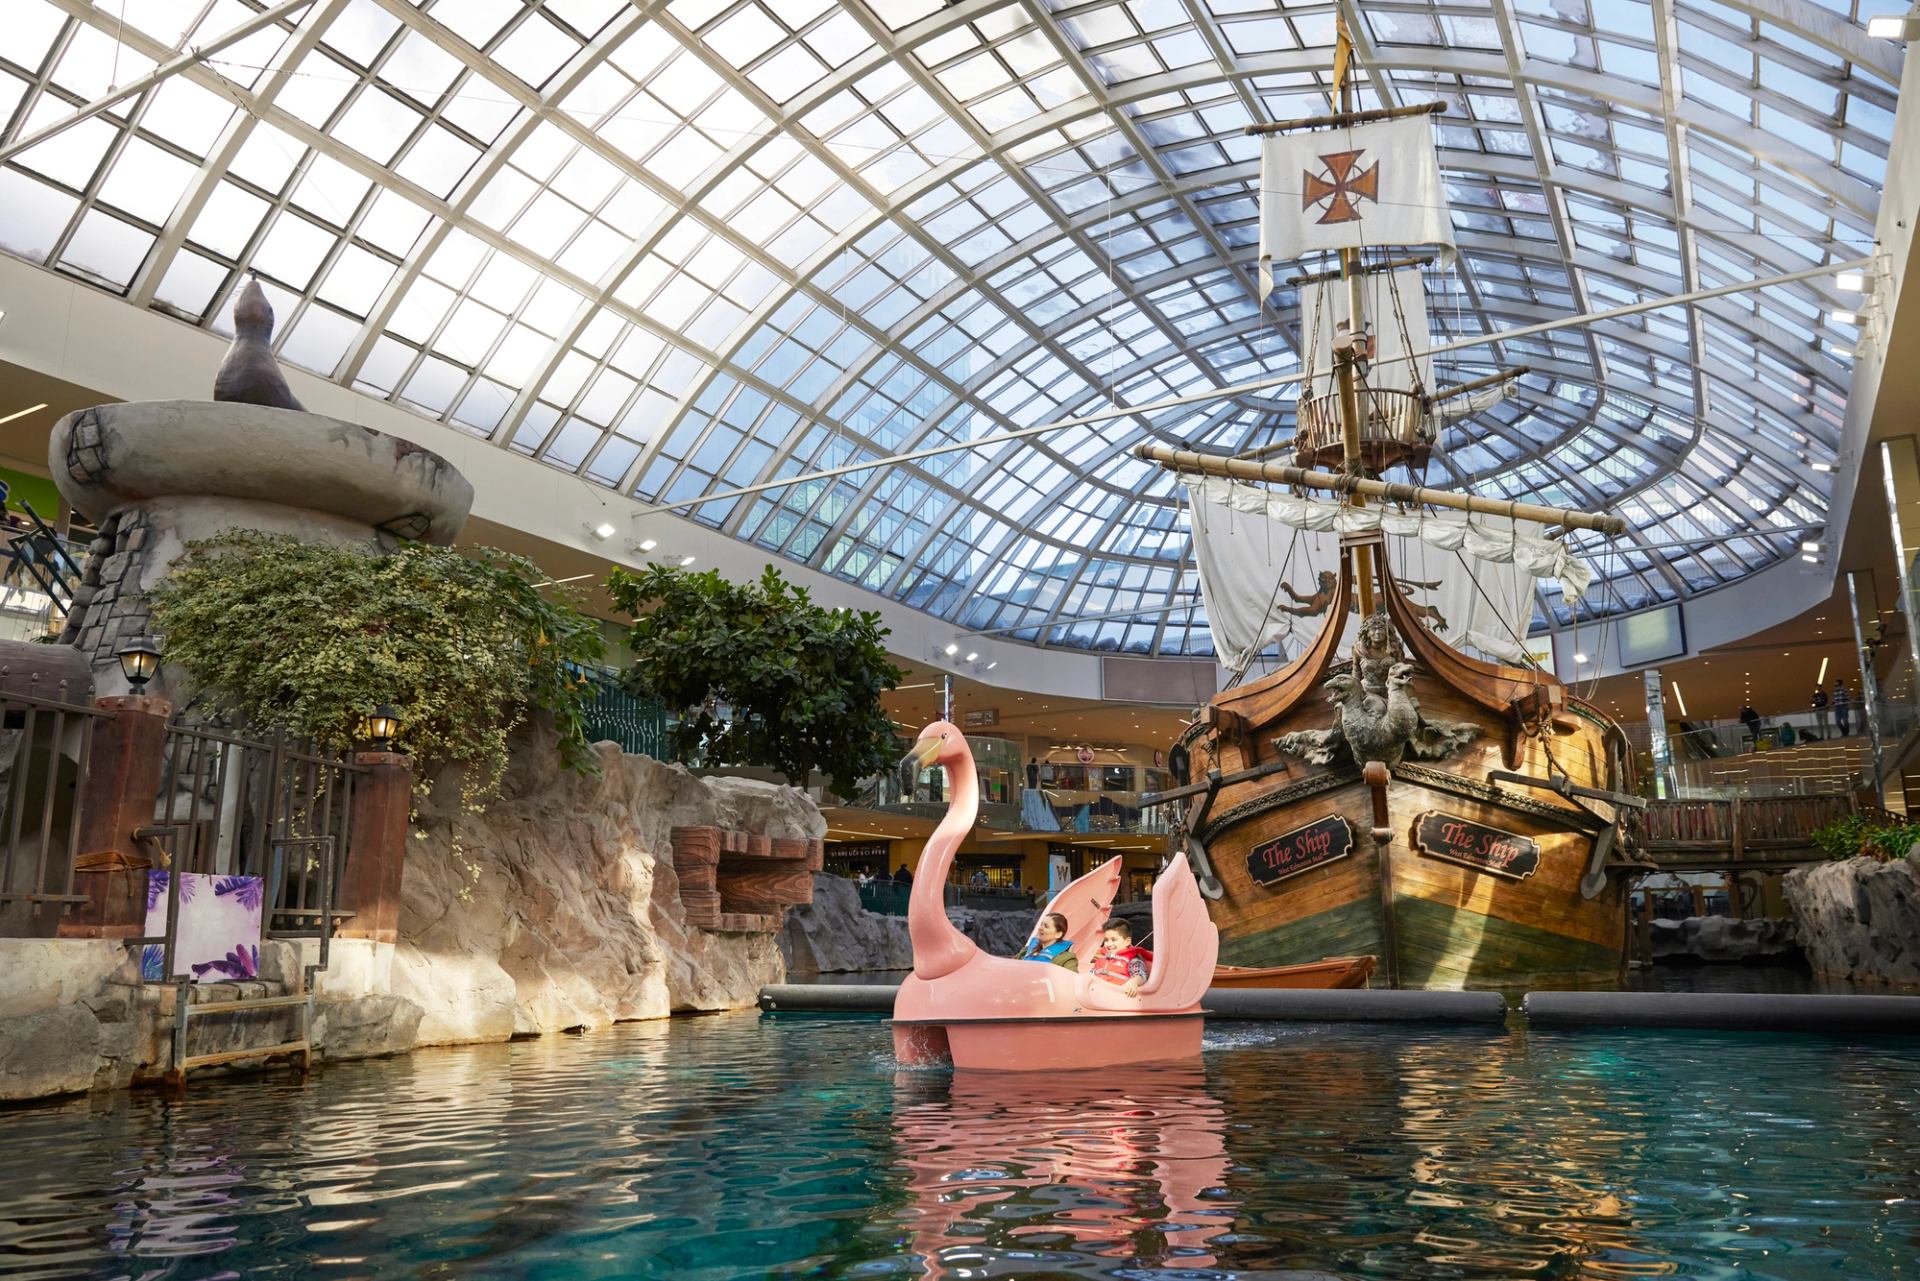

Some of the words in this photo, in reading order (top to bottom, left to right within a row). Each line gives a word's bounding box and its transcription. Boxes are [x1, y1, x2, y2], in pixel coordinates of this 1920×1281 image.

[1263, 842, 1292, 869] The
[1296, 829, 1331, 859] Ship
[1441, 822, 1475, 848] The
[1475, 834, 1520, 868] Ship
